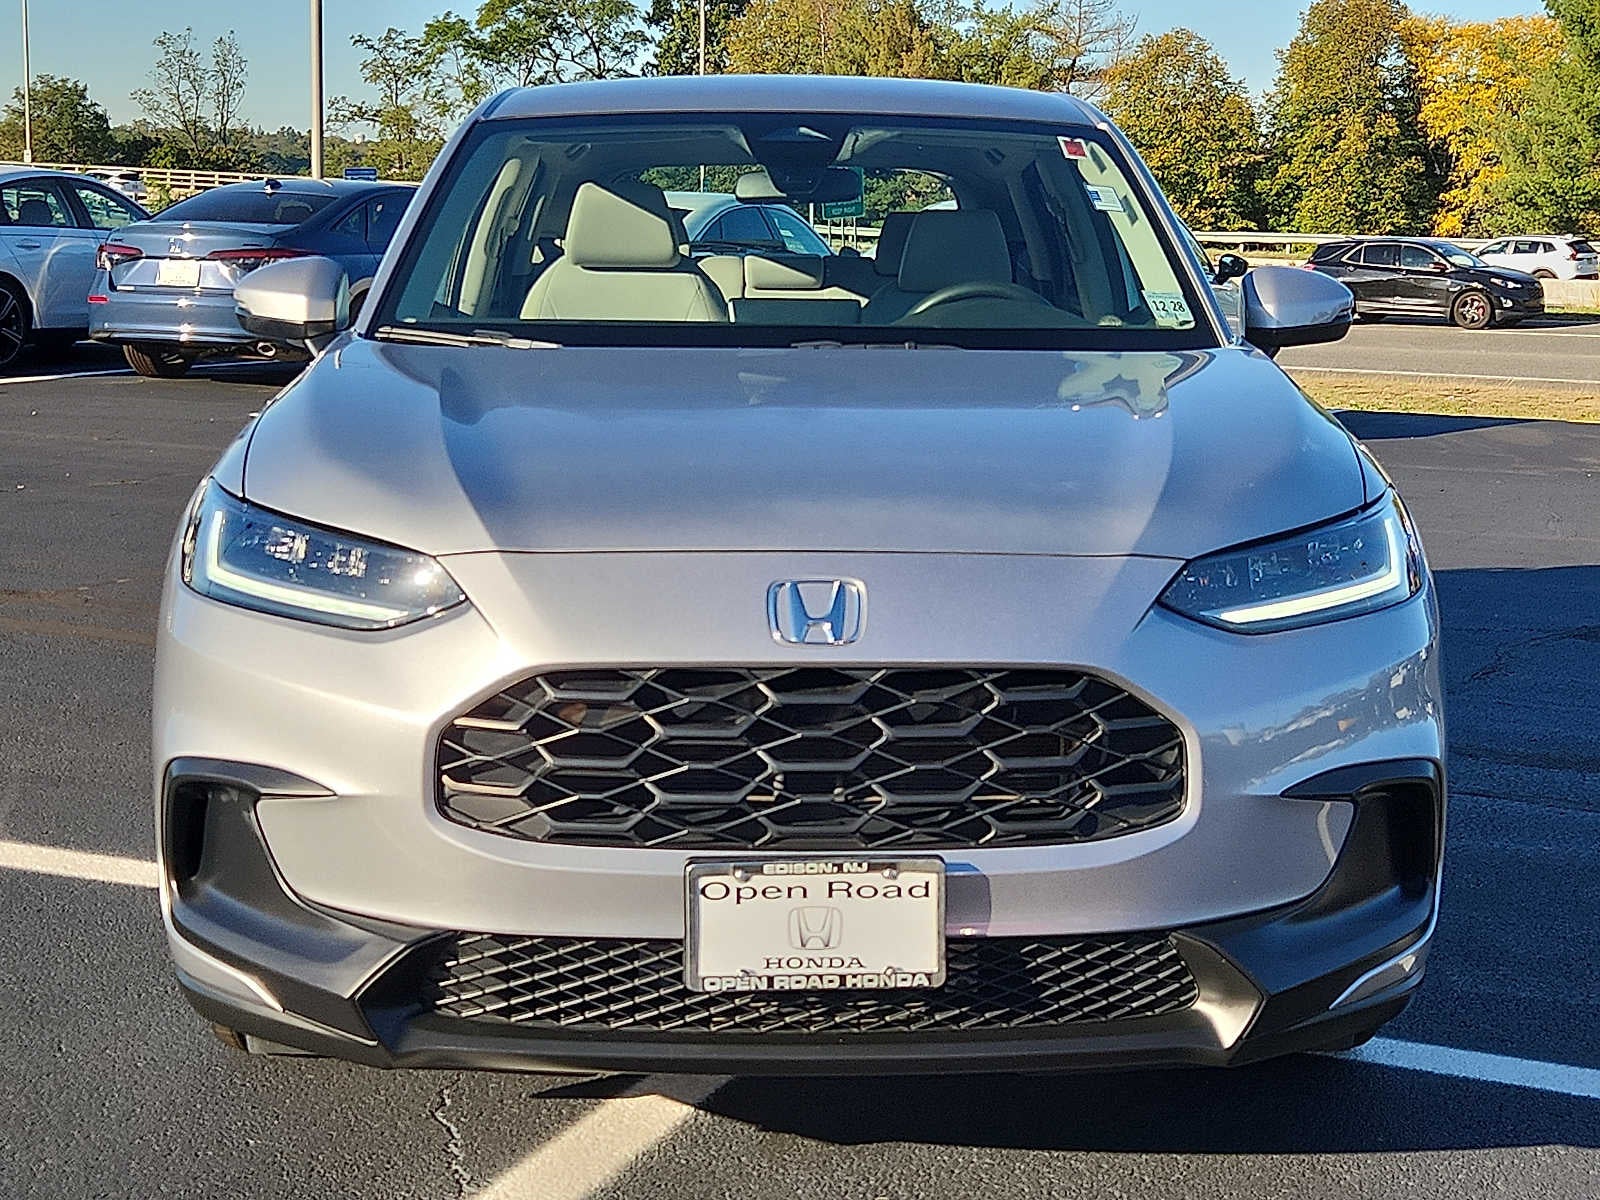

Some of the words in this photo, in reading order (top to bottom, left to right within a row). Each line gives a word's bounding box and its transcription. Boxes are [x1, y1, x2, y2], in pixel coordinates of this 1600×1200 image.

[1152, 300, 1169, 313] 12
[1170, 300, 1186, 313] 28
[842, 862, 869, 873] NJ
[700, 881, 809, 905] Open
[827, 880, 931, 900] Road
[763, 956, 867, 970] HONDA
[703, 975, 768, 992] OPEN
[773, 974, 840, 990] ROAD
[845, 972, 930, 988] HONDA
